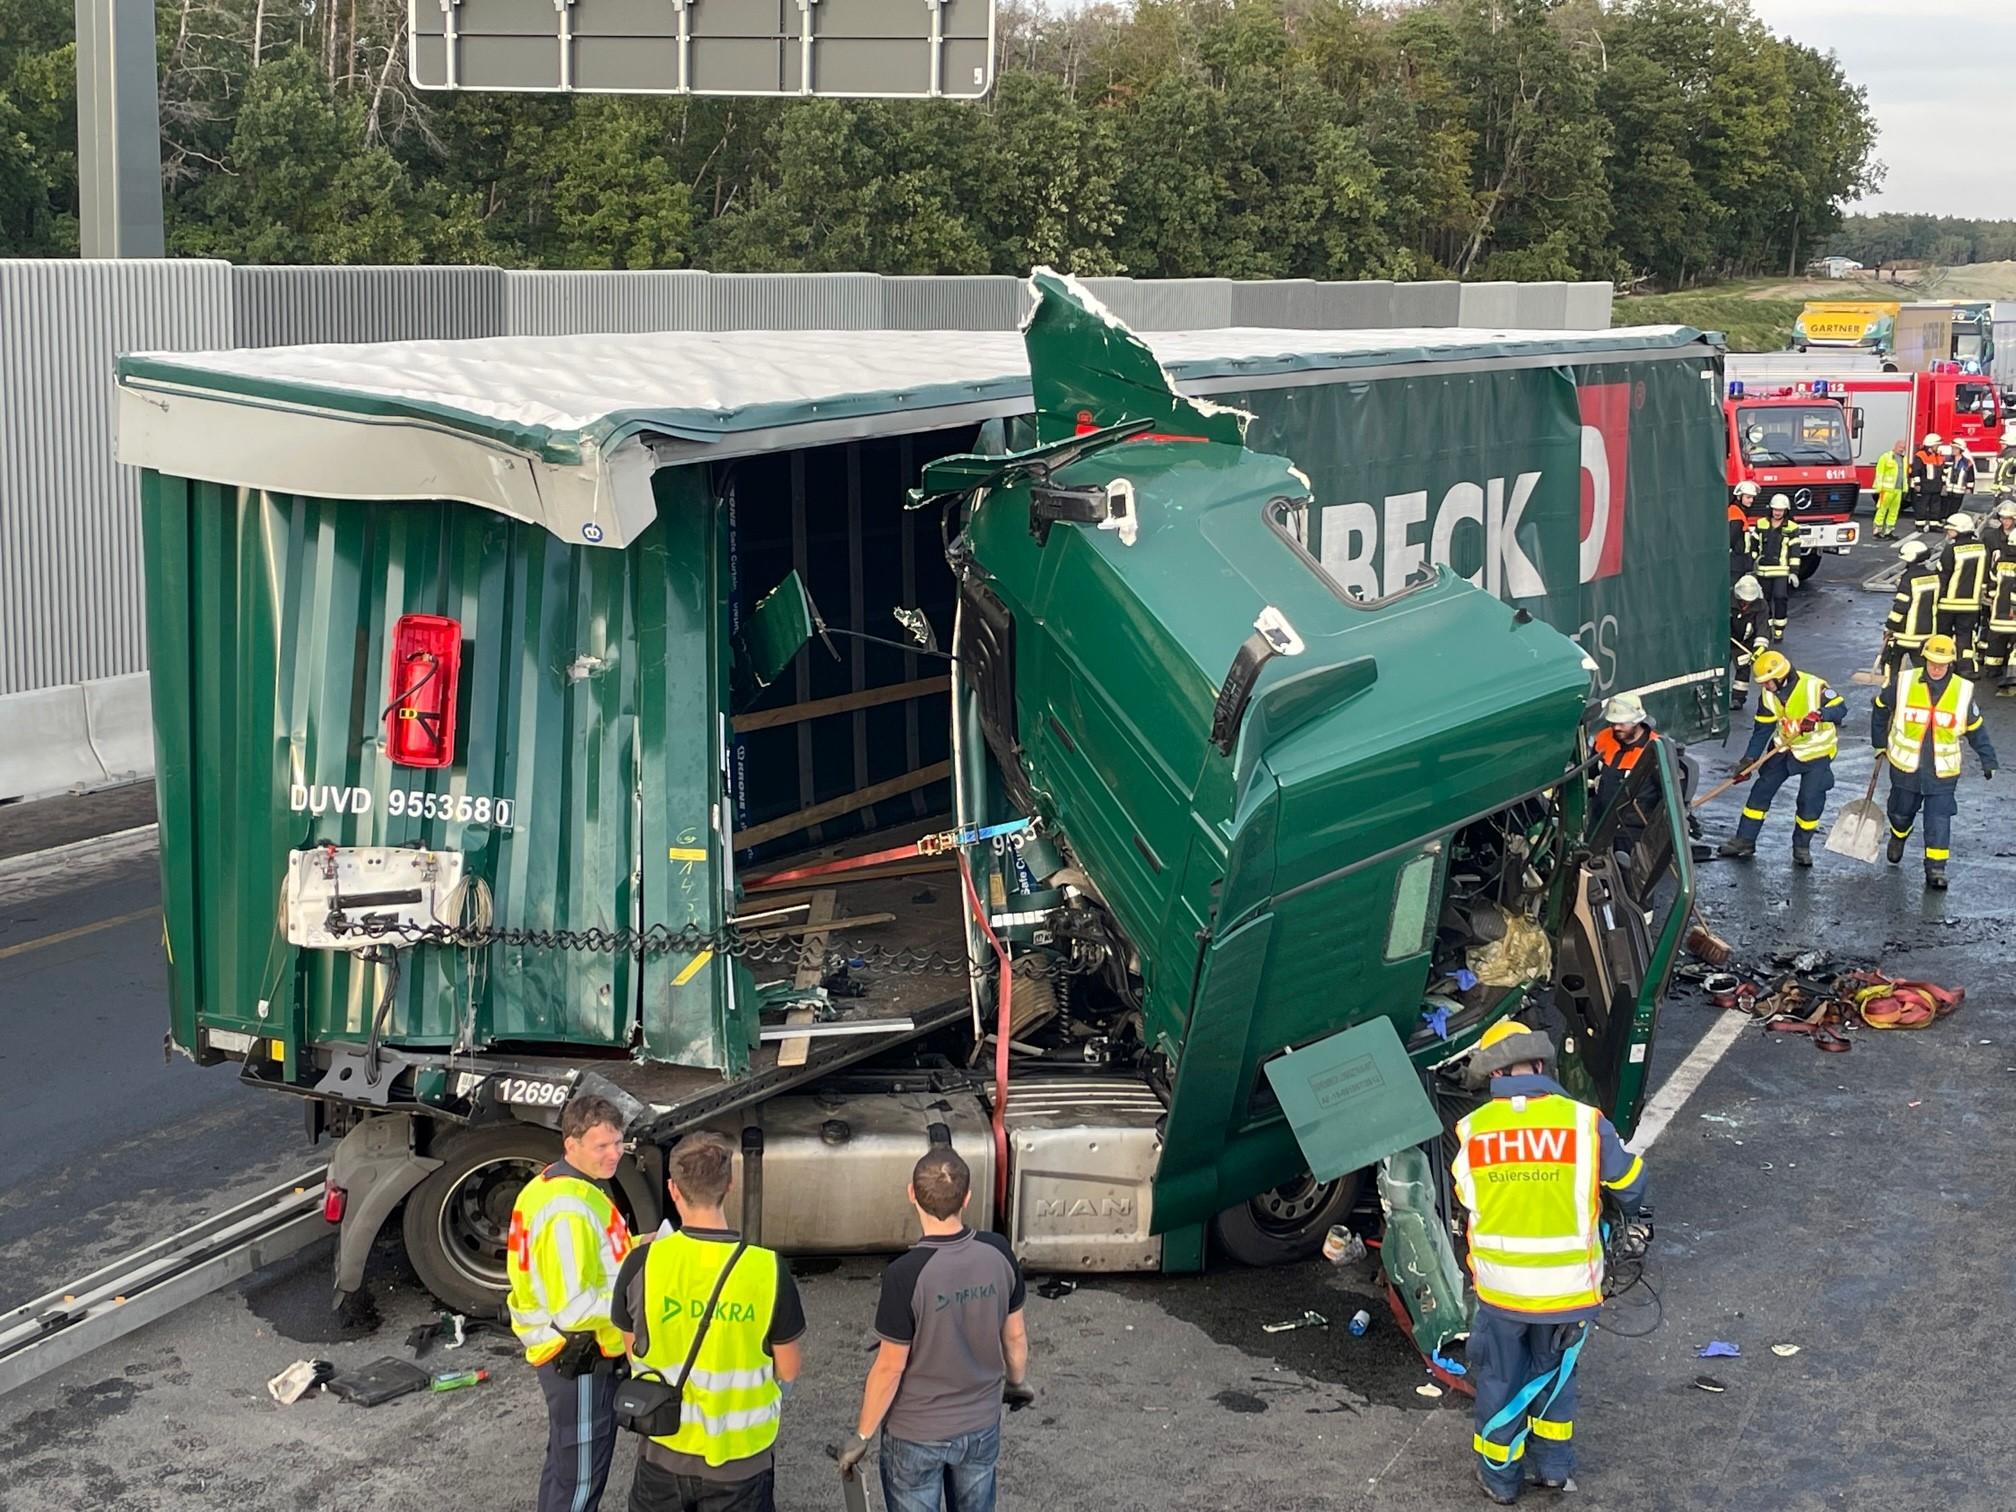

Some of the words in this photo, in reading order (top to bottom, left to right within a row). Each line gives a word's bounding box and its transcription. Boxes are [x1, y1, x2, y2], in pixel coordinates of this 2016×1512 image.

[1810, 323, 1860, 333] GARTNER
[1826, 469, 1846, 480] 61/1
[290, 784, 372, 816] DUVD
[499, 1078, 569, 1105] 12696
[1474, 1128, 1568, 1165] THW
[1488, 1169, 1560, 1183] Baiersdorf
[1036, 1198, 1131, 1217] MAN
[690, 1300, 756, 1323] DKRA
